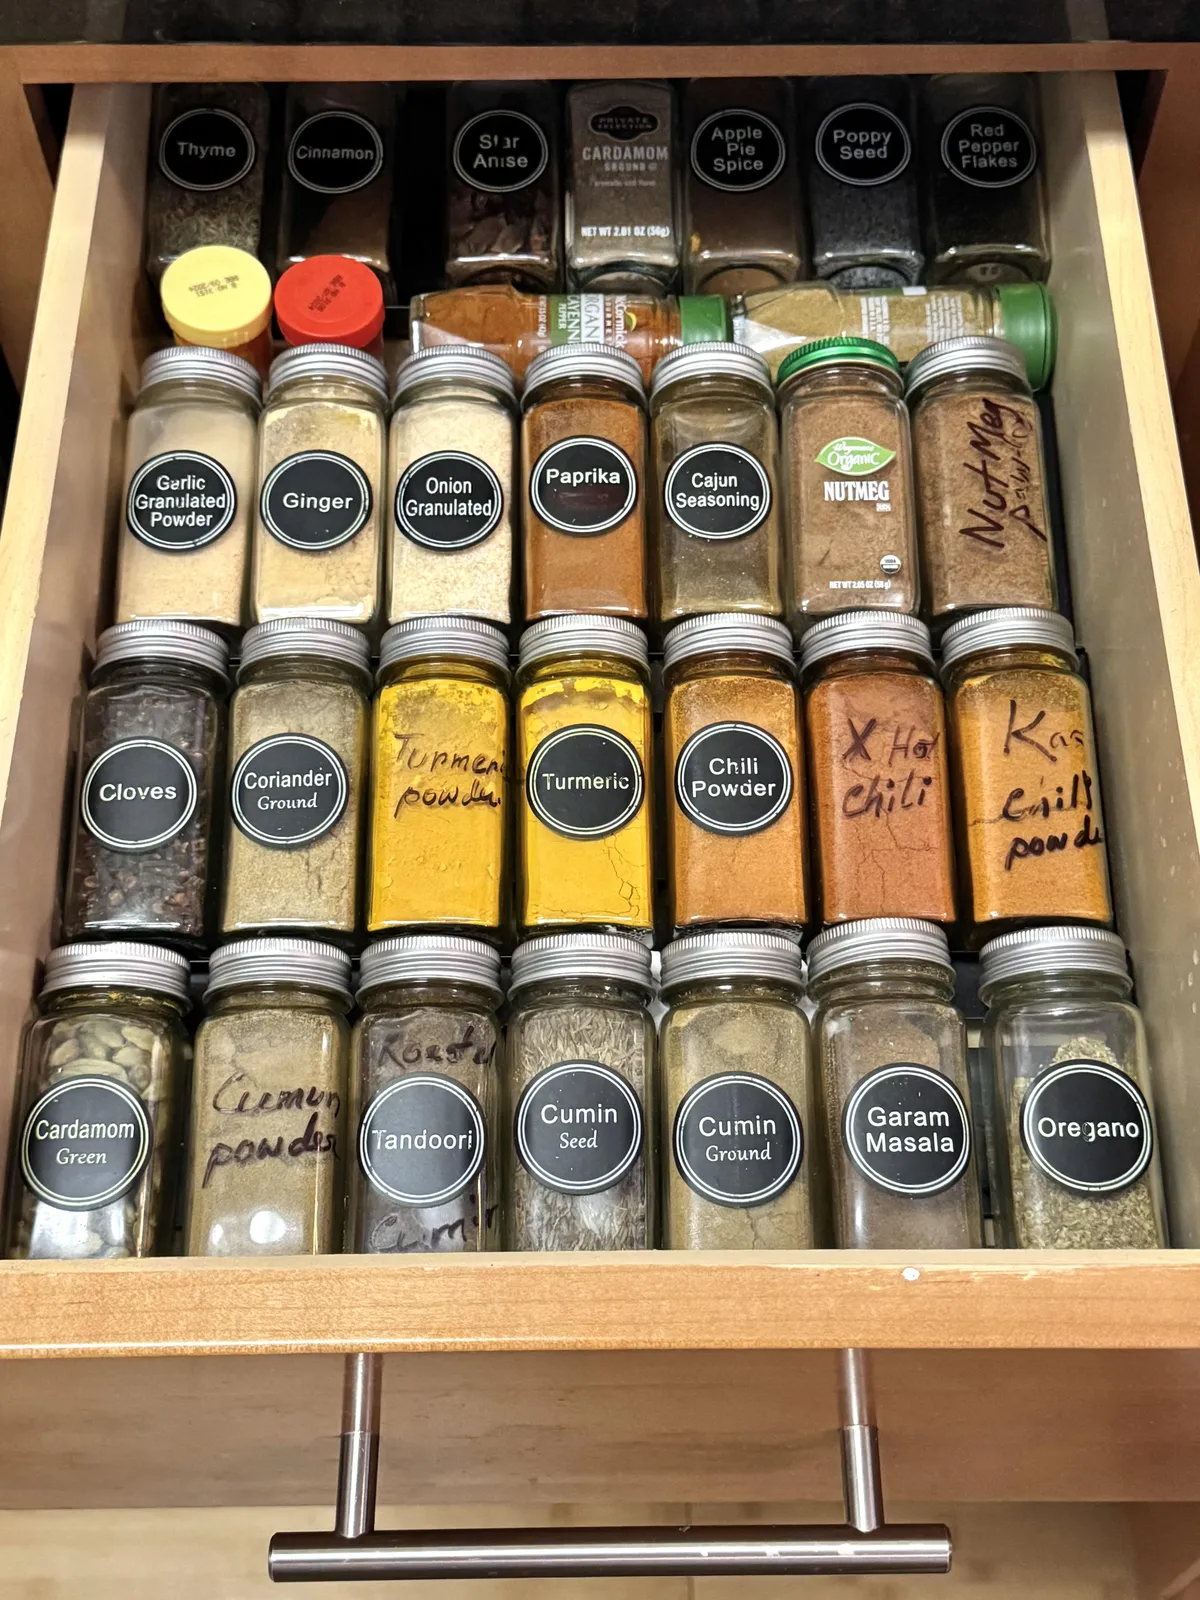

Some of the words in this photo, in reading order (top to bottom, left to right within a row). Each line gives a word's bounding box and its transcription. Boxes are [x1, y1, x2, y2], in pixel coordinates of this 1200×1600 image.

[711, 126, 762, 142] Apple
[834, 130, 891, 147] Poppy
[971, 124, 1004, 136] Red
[178, 142, 235, 158] Thyme
[480, 135, 519, 149] Star
[727, 143, 755, 156] Pie
[959, 140, 1019, 156] Pepper
[297, 146, 373, 160] Cinnamon
[582, 146, 669, 160] CARDAMOM
[840, 144, 887, 159] Seed
[474, 154, 528, 168] Anise
[714, 158, 763, 174] Spice
[962, 155, 1017, 168] Flakes
[581, 226, 597, 237] NET
[598, 226, 612, 237] WT
[634, 226, 646, 237] OZ
[558, 303, 567, 329] PEPPER
[157, 475, 205, 490] Garlic
[426, 477, 471, 494] Onion
[547, 468, 620, 487] Paprika
[692, 473, 737, 491] Cajun
[824, 481, 890, 501] NUTMEG
[135, 493, 226, 509] Granulated
[283, 493, 353, 512] Ginger
[405, 499, 492, 516] Granulated
[676, 493, 760, 511] Seasoning
[151, 512, 213, 527] Powder
[829, 581, 841, 589] NET
[842, 718, 876, 761] X
[709, 758, 757, 775] Chili
[244, 770, 332, 789] Coriander
[542, 773, 629, 790] Turmeric
[100, 784, 176, 801] Cloves
[692, 780, 775, 797] Powder
[258, 792, 317, 810] Ground
[541, 1104, 617, 1124] Cumin
[868, 1107, 949, 1126] Garam
[35, 1119, 134, 1140] Cardamom
[699, 1115, 775, 1136] Cumin
[1037, 1117, 1139, 1141] Oregano
[372, 1130, 472, 1150] Tandoori
[560, 1130, 597, 1148] Seed
[866, 1133, 954, 1152] Masala
[57, 1148, 106, 1164] Green
[706, 1142, 771, 1161] Ground
